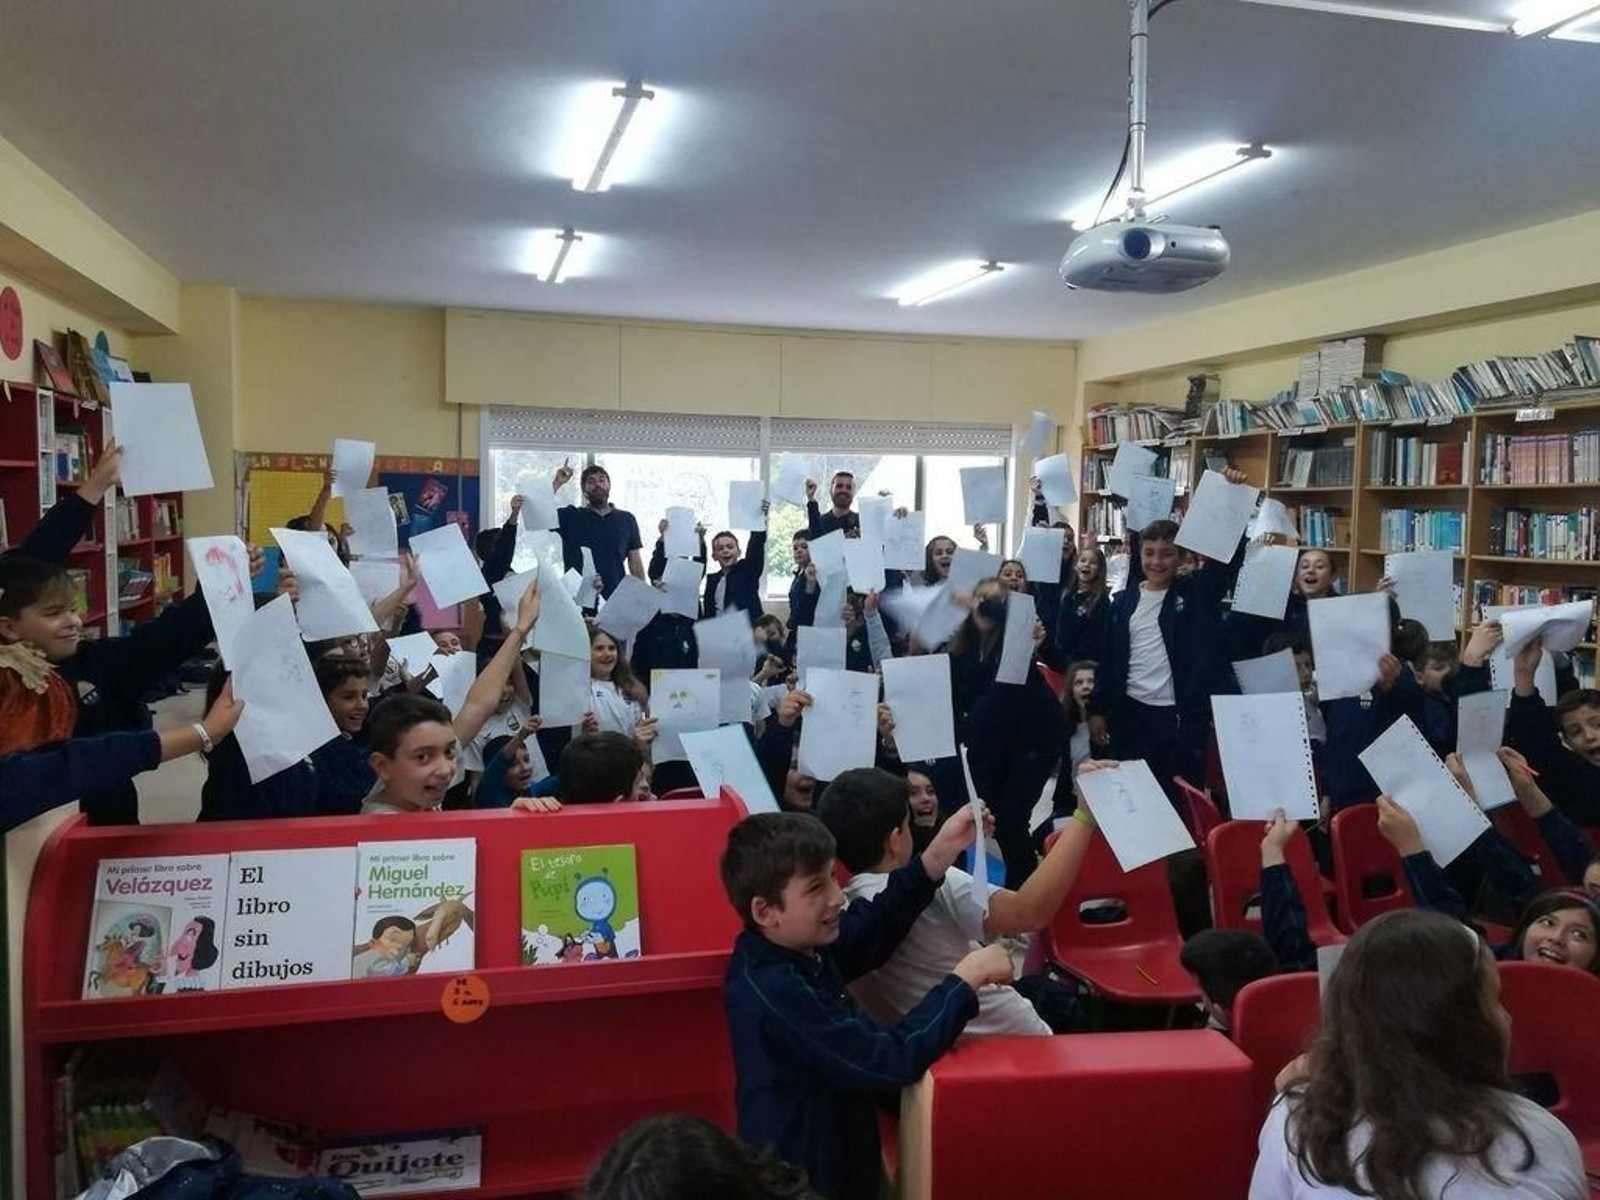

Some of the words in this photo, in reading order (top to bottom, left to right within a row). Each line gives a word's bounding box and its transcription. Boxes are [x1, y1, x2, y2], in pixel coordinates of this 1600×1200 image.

[382, 854, 409, 863] primer
[412, 853, 430, 861] libro
[432, 852, 455, 860] sobre
[530, 857, 544, 871] El
[548, 854, 582, 869] tesoro
[107, 866, 119, 874] Mi
[121, 865, 151, 875] primer
[154, 863, 174, 872] libro
[176, 862, 202, 871] sobre
[239, 866, 263, 884] El
[369, 864, 429, 884] Miguel
[106, 877, 213, 896] Velázquez
[368, 881, 465, 899] Hernández
[530, 877, 571, 900] Pupi
[237, 897, 290, 915] libro
[234, 929, 268, 947] sin
[232, 959, 313, 980] dibujos
[327, 1151, 464, 1179] Quijote
